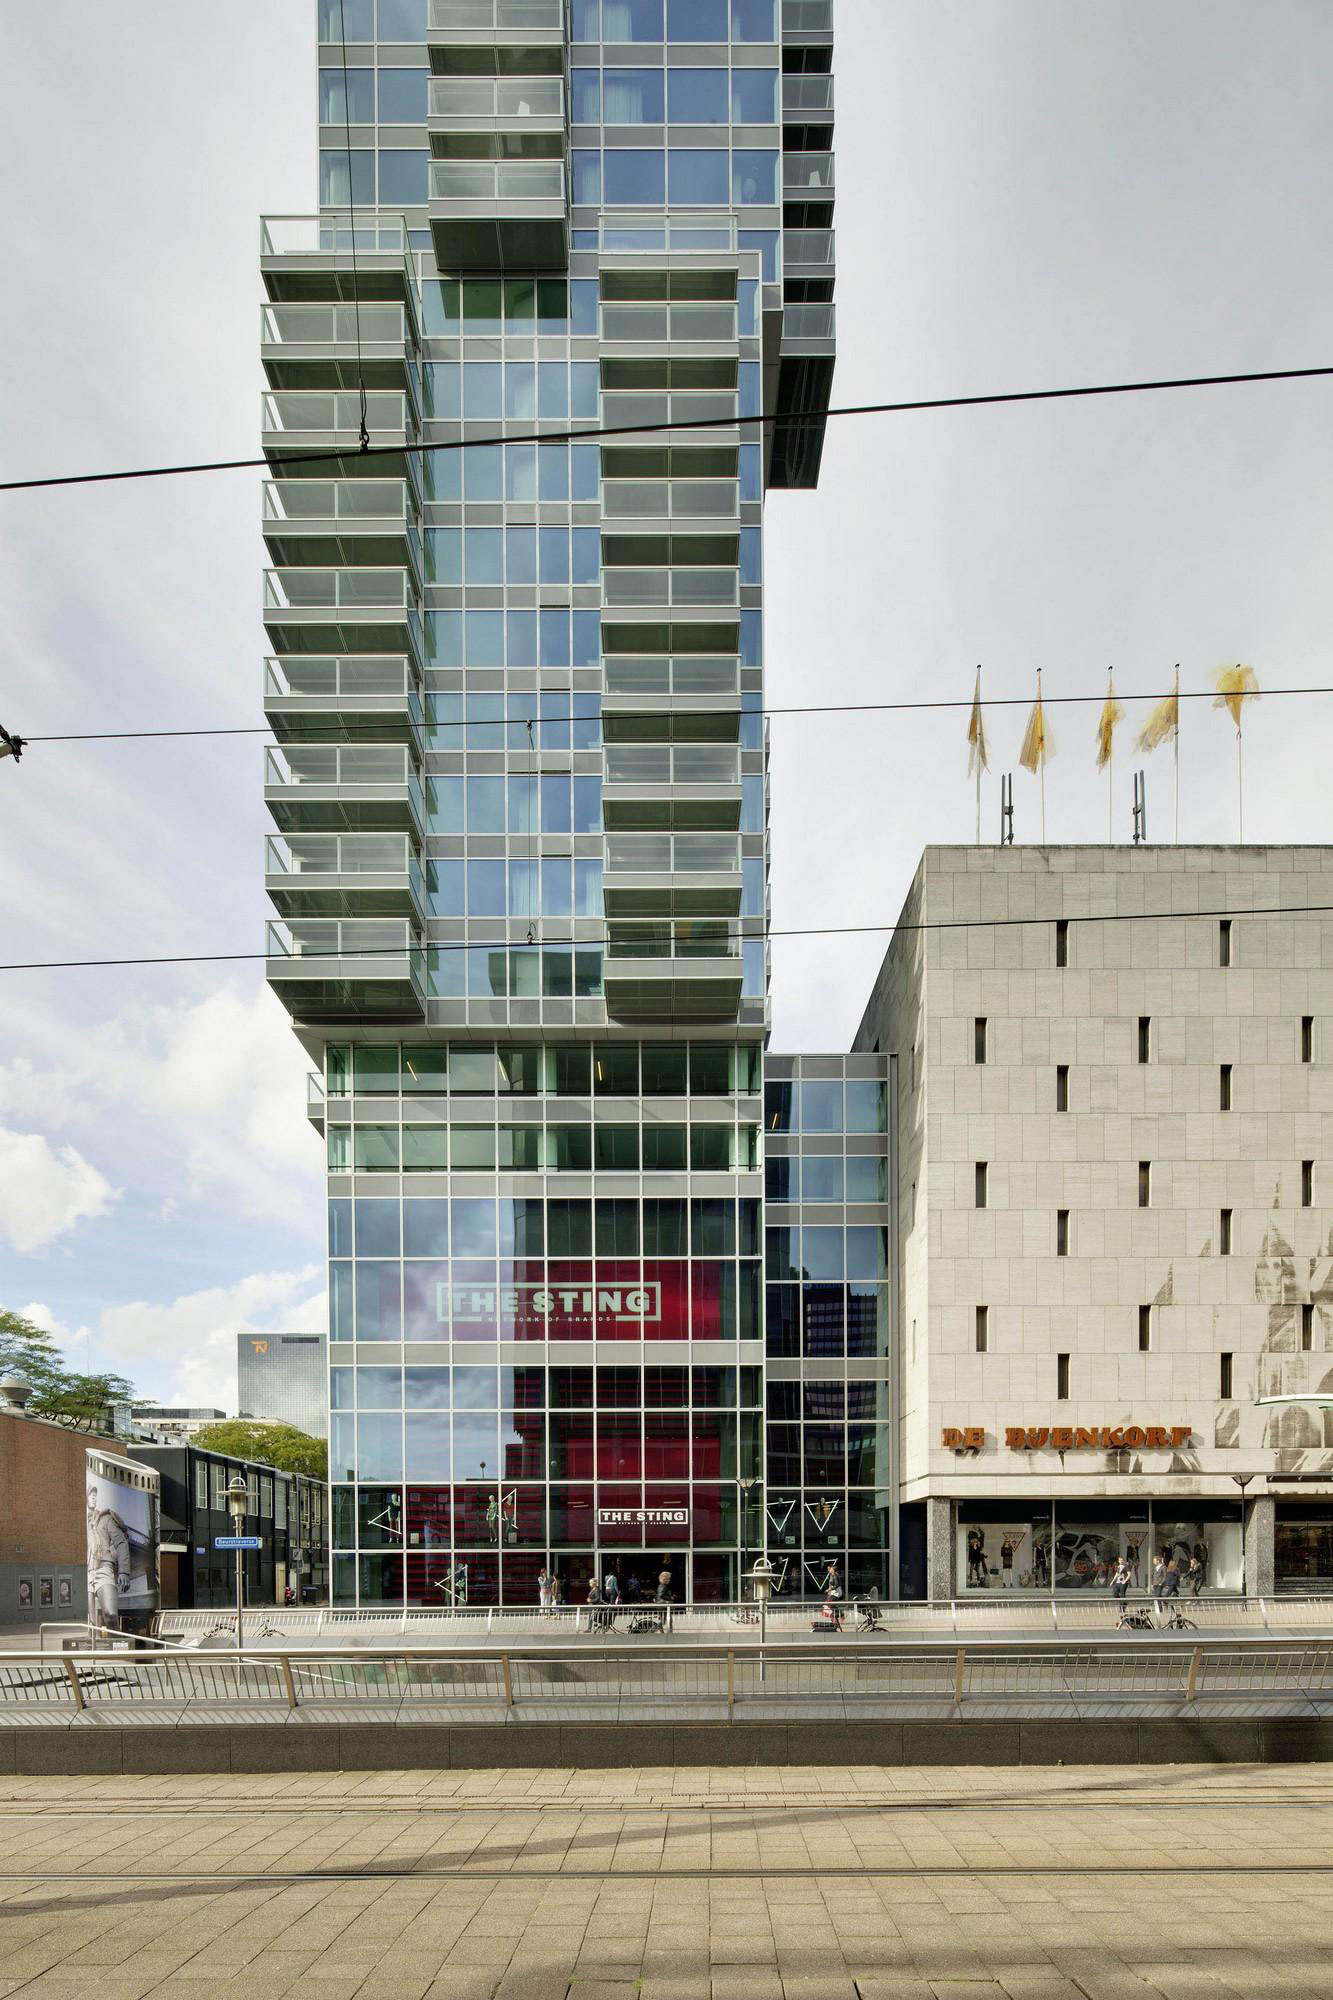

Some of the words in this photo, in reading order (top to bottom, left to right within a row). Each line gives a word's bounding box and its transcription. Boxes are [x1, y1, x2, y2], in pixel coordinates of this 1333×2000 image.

[450, 1292, 518, 1312] THE
[533, 1291, 650, 1313] STING
[942, 1427, 985, 1447] DE
[602, 1512, 631, 1521] THE
[636, 1512, 684, 1521] STING
